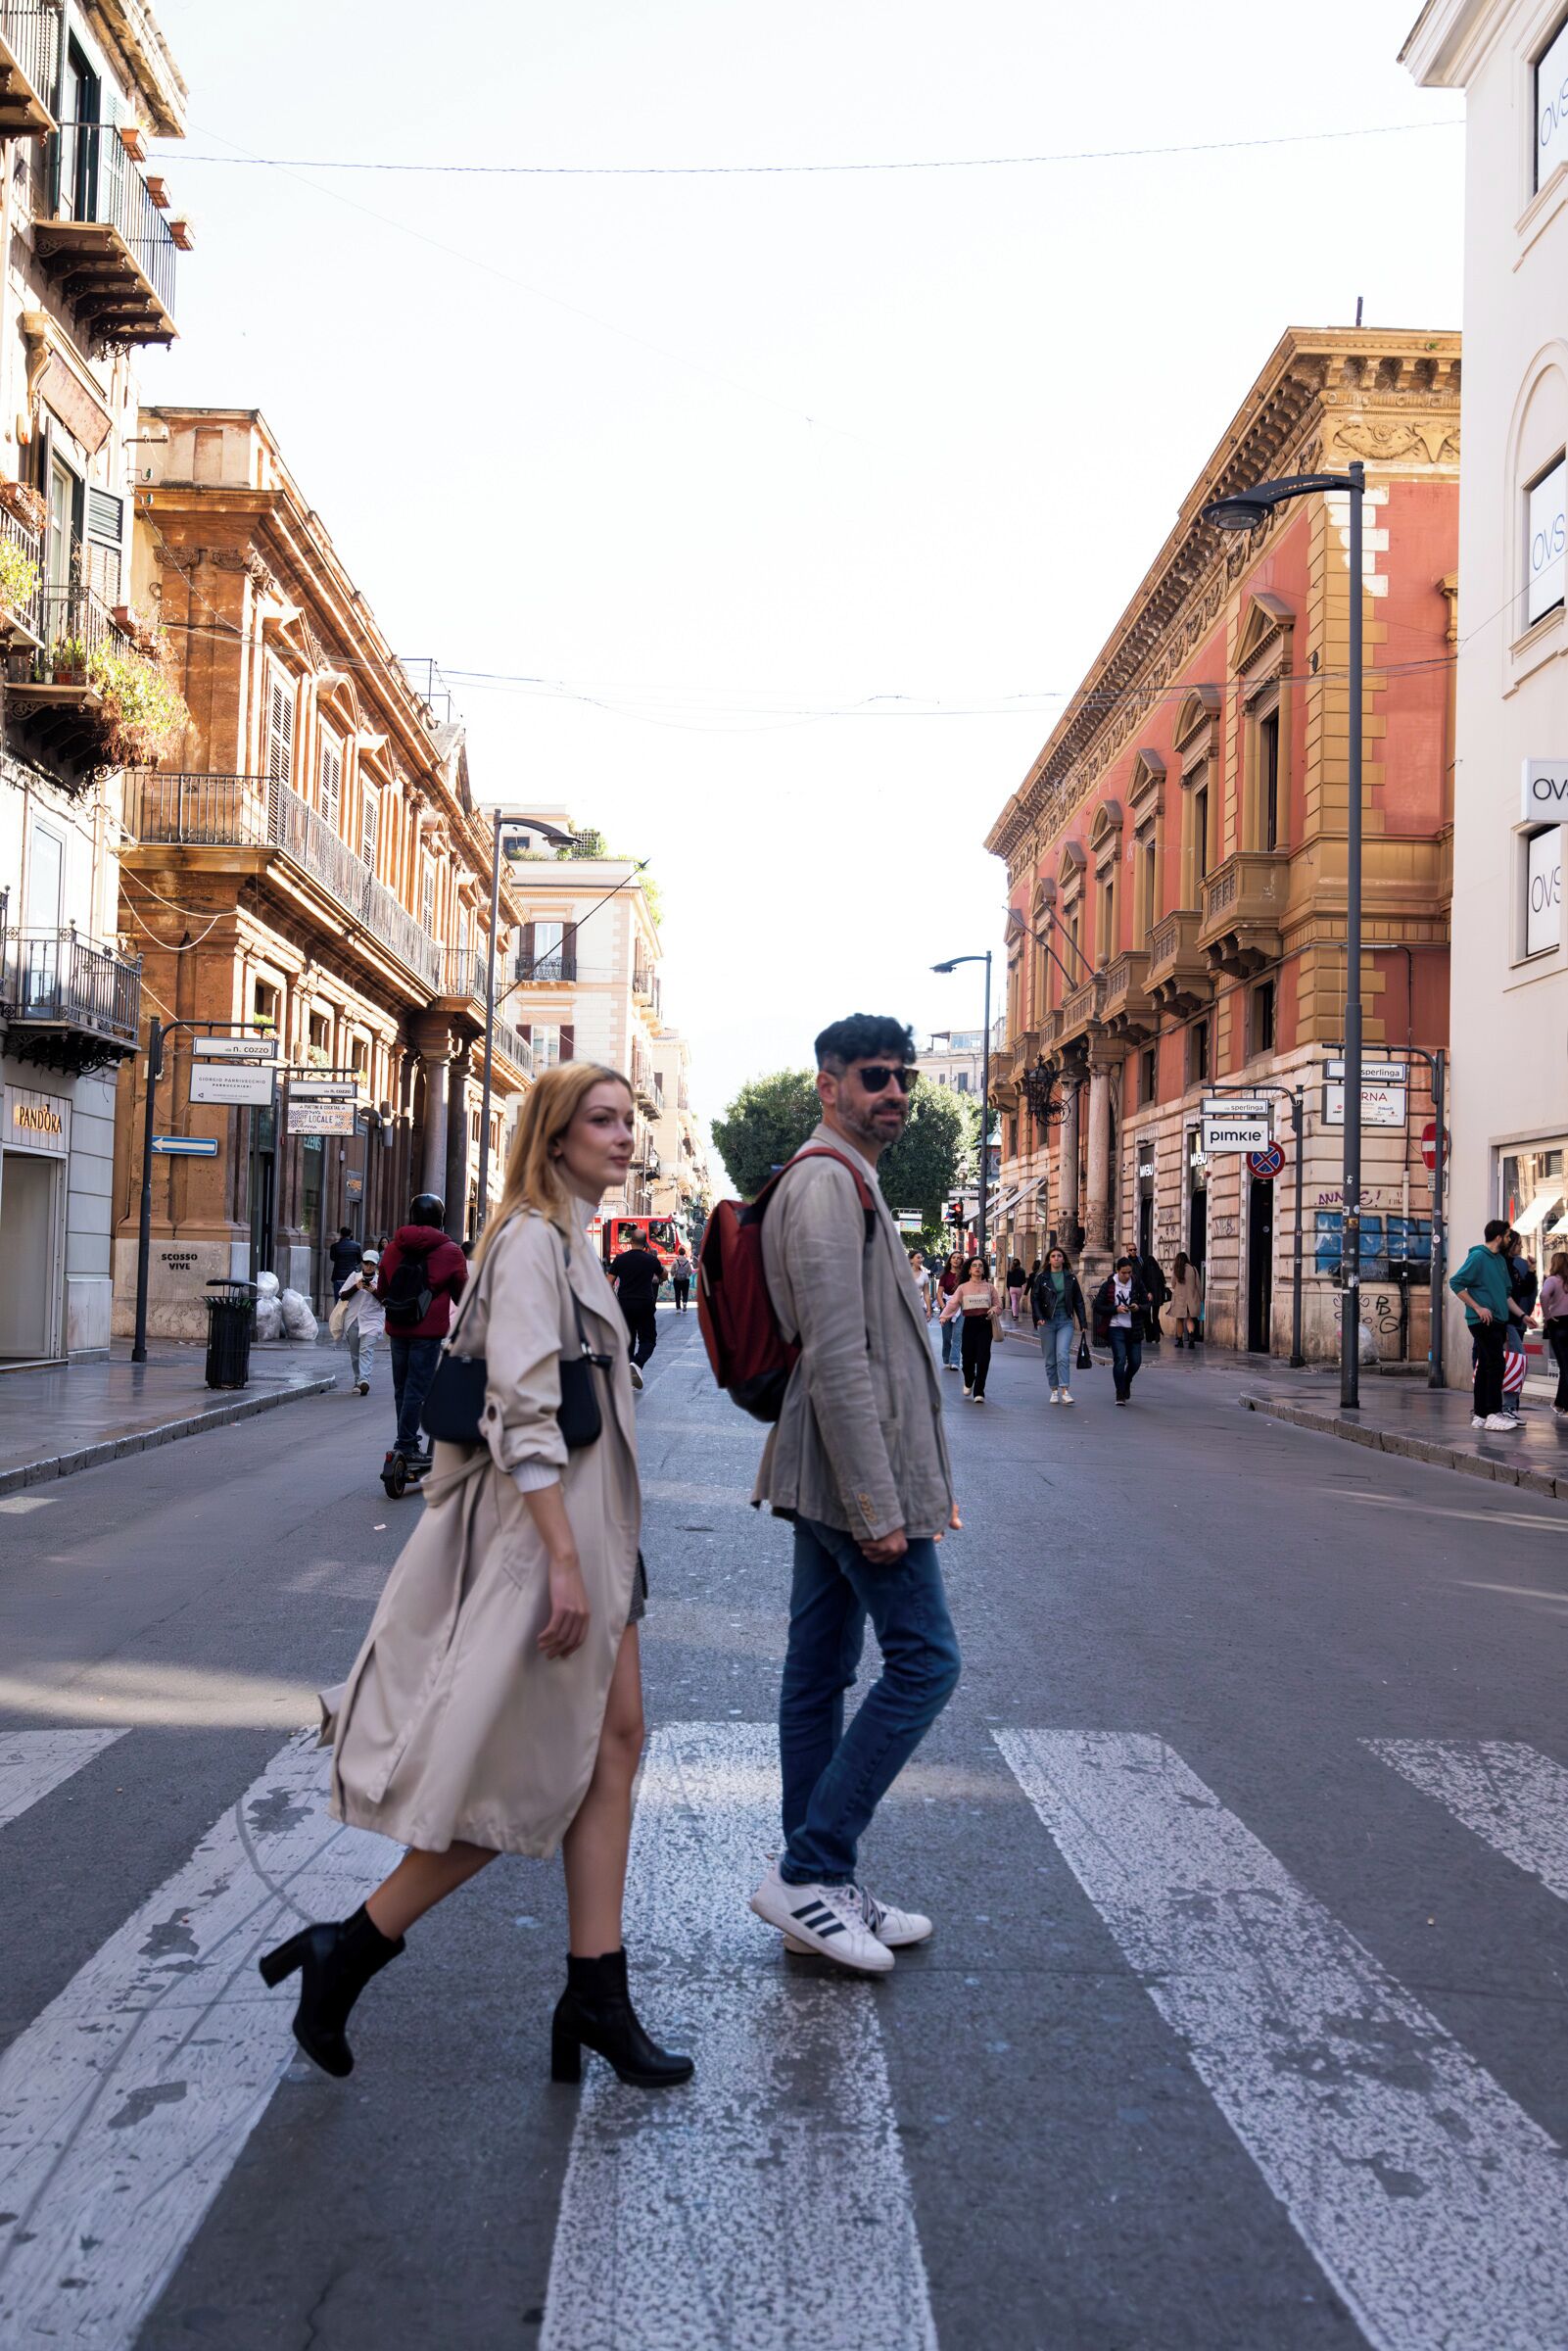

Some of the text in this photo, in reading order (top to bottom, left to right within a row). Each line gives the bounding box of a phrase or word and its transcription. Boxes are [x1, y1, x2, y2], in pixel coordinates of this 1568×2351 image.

[1533, 513, 1565, 571] OVS
[1533, 778, 1568, 800] OV
[1360, 1068, 1401, 1078] sperlinga
[19, 1106, 63, 1133] PANDORA
[309, 1115, 333, 1124] LOCALE
[1210, 1130, 1261, 1144] pimkie
